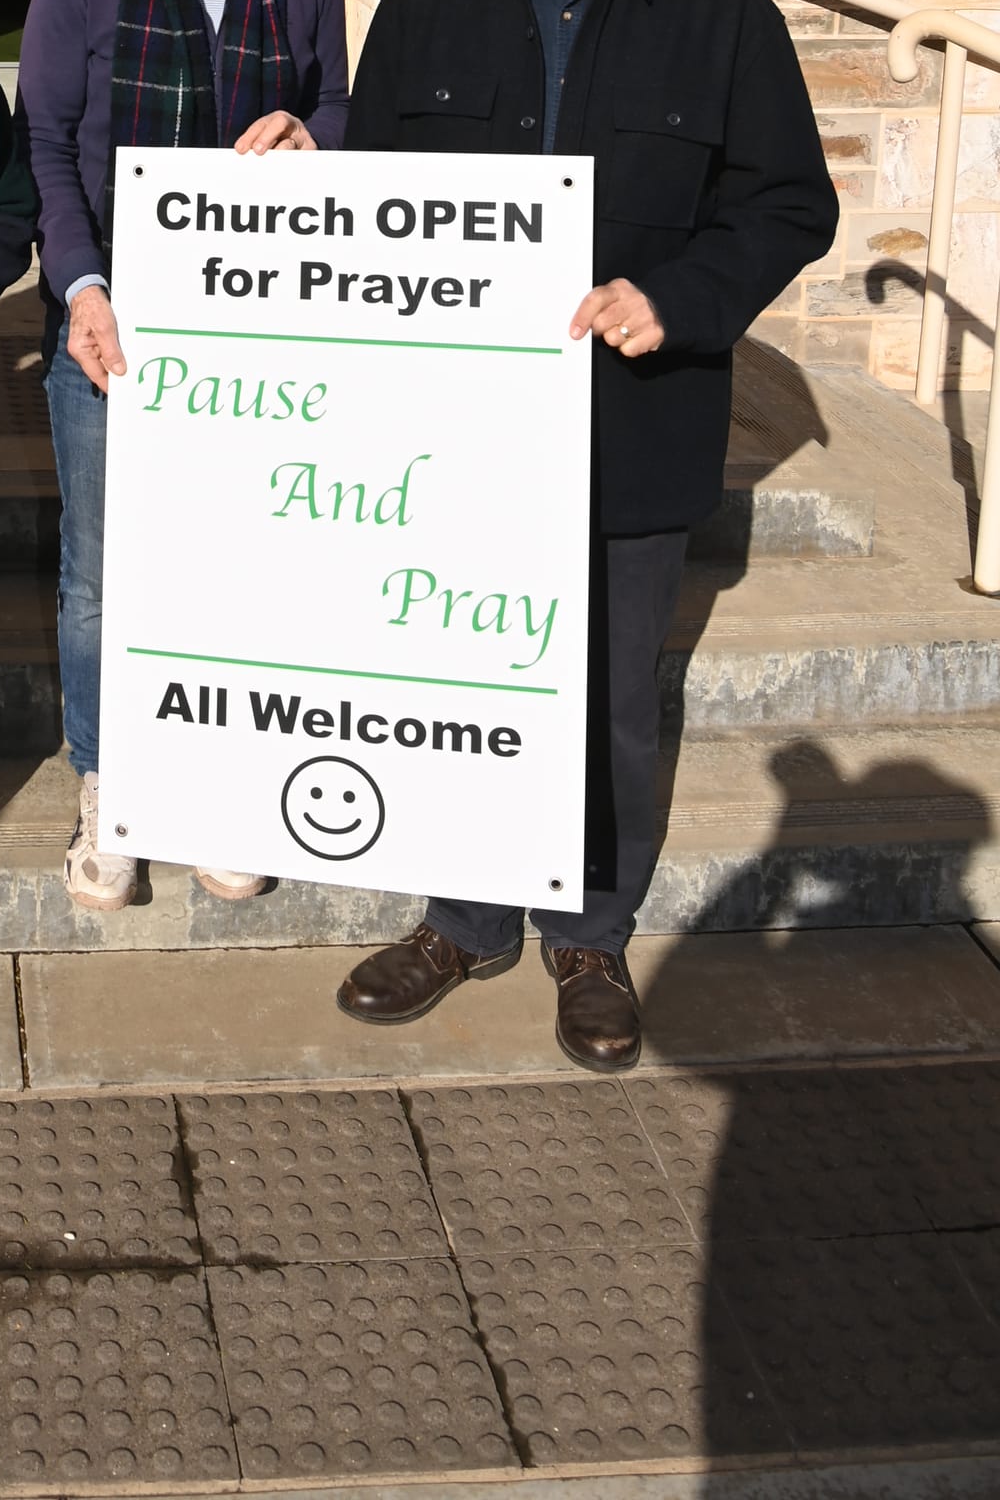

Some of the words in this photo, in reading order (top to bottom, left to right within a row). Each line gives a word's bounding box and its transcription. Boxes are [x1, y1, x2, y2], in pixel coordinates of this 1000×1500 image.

[157, 192, 354, 236] Church
[376, 198, 542, 243] OPEN
[202, 257, 280, 298] for
[300, 261, 492, 316] Prayer
[138, 357, 327, 422] Pause
[271, 454, 432, 526] And
[382, 568, 558, 670] Pray
[156, 682, 227, 727] All
[249, 691, 522, 757] Welcome
